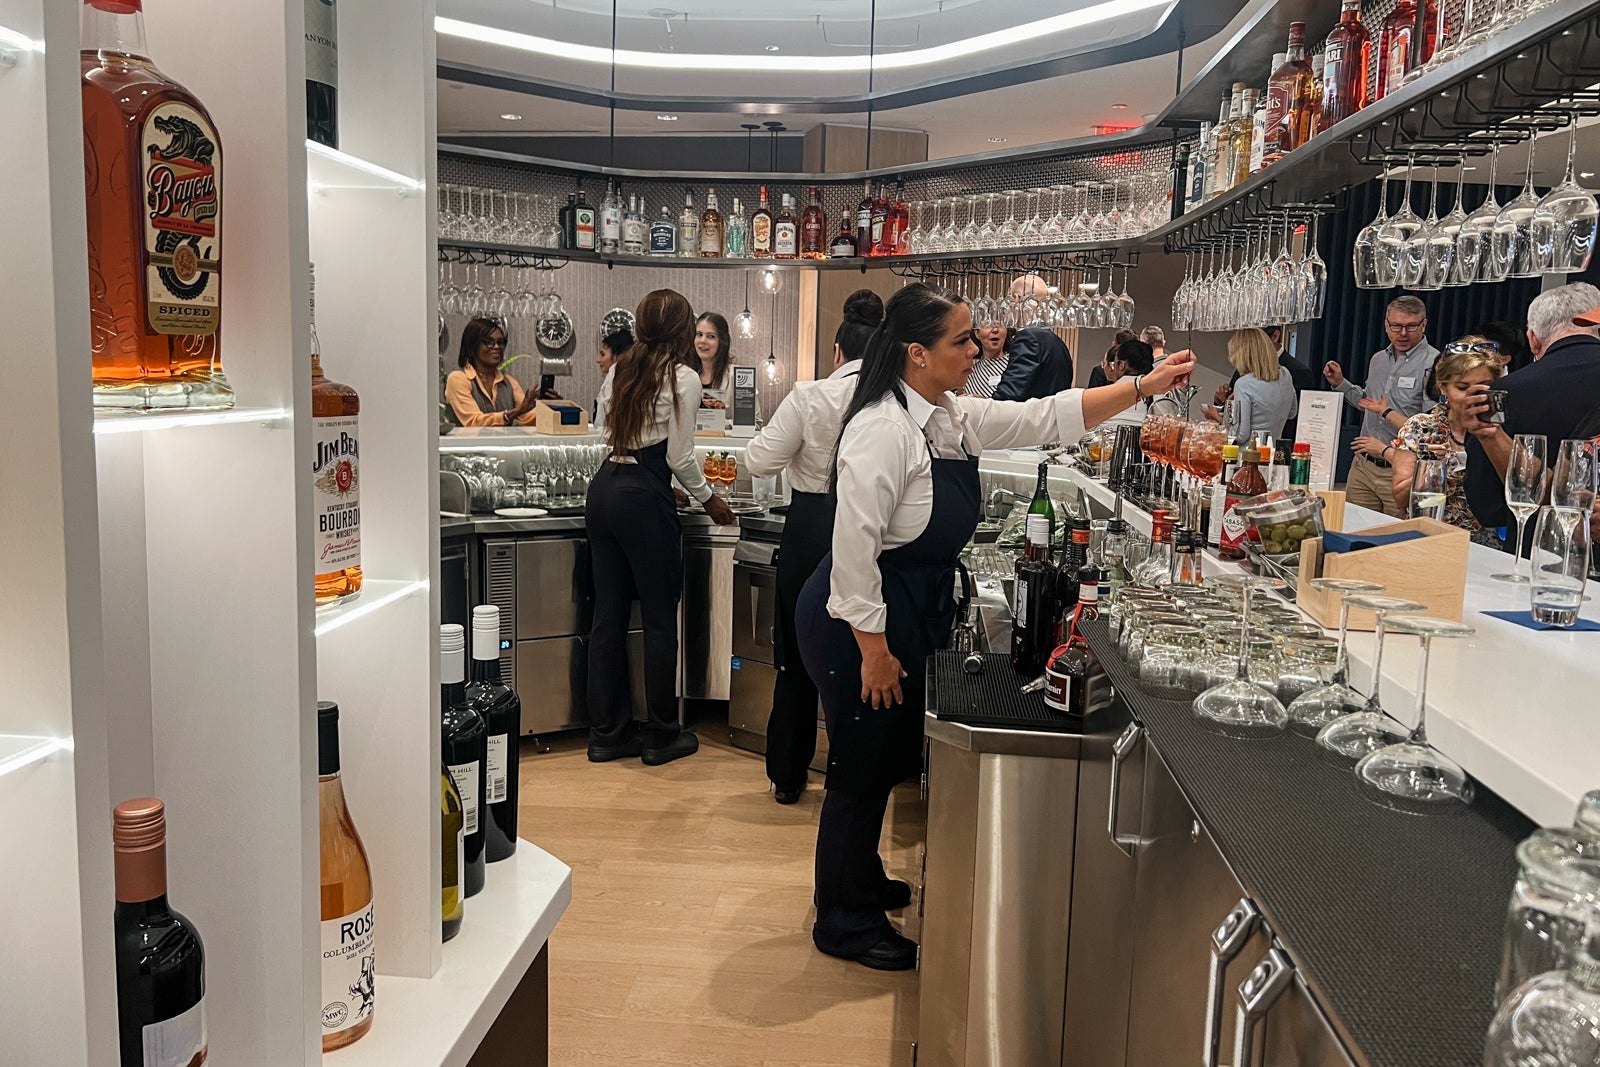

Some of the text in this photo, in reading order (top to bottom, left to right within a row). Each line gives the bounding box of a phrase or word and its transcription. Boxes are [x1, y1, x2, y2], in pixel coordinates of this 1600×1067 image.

[305, 33, 331, 48] ANYON
[1267, 97, 1281, 110] nt's
[147, 164, 213, 218] Bayou
[159, 305, 210, 317] SPICED
[313, 431, 359, 473] JIM BEA
[327, 503, 345, 512] KENTUCKY
[1224, 517, 1244, 526] TABASC
[323, 939, 366, 958] COLUMBIA
